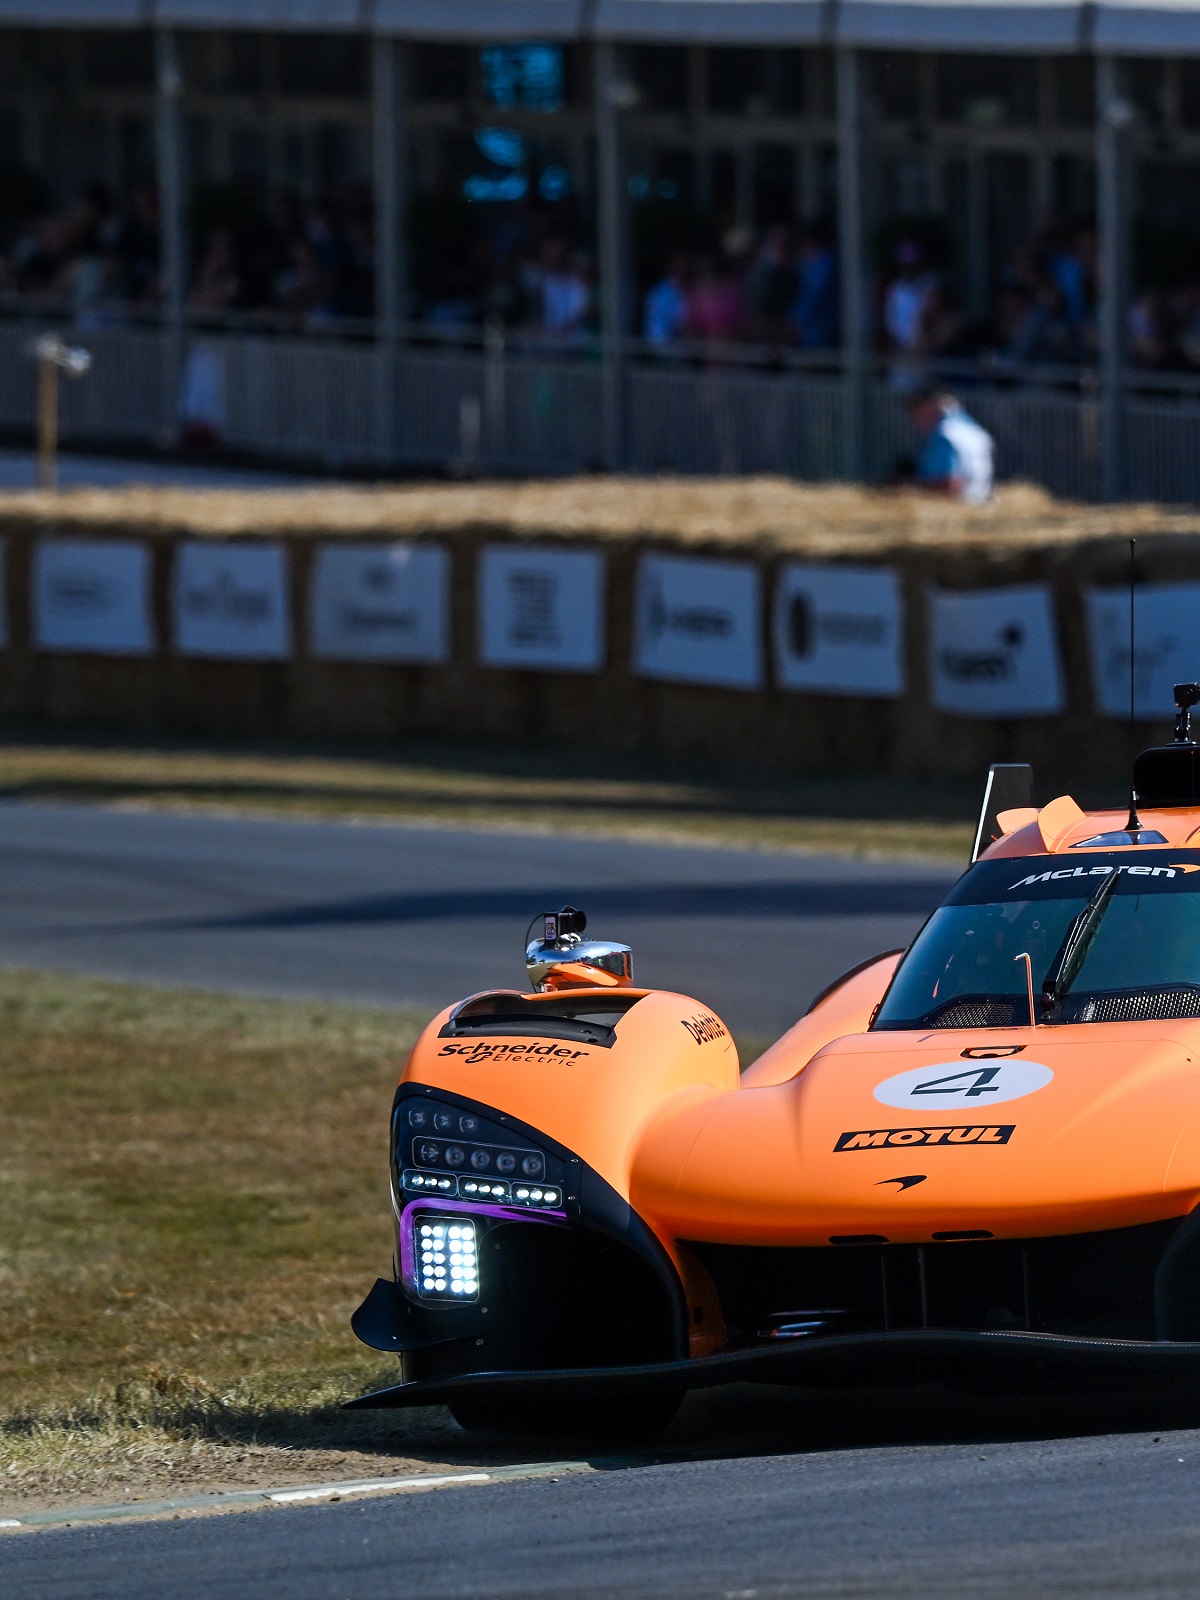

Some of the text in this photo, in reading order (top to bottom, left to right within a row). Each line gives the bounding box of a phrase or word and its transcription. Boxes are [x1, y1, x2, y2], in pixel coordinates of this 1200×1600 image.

[1007, 865, 1177, 891] McLaren
[437, 1042, 590, 1059] Schneider
[492, 1053, 577, 1067] Electric
[910, 1067, 1002, 1097] 4
[842, 1127, 1003, 1149] MOTUL
